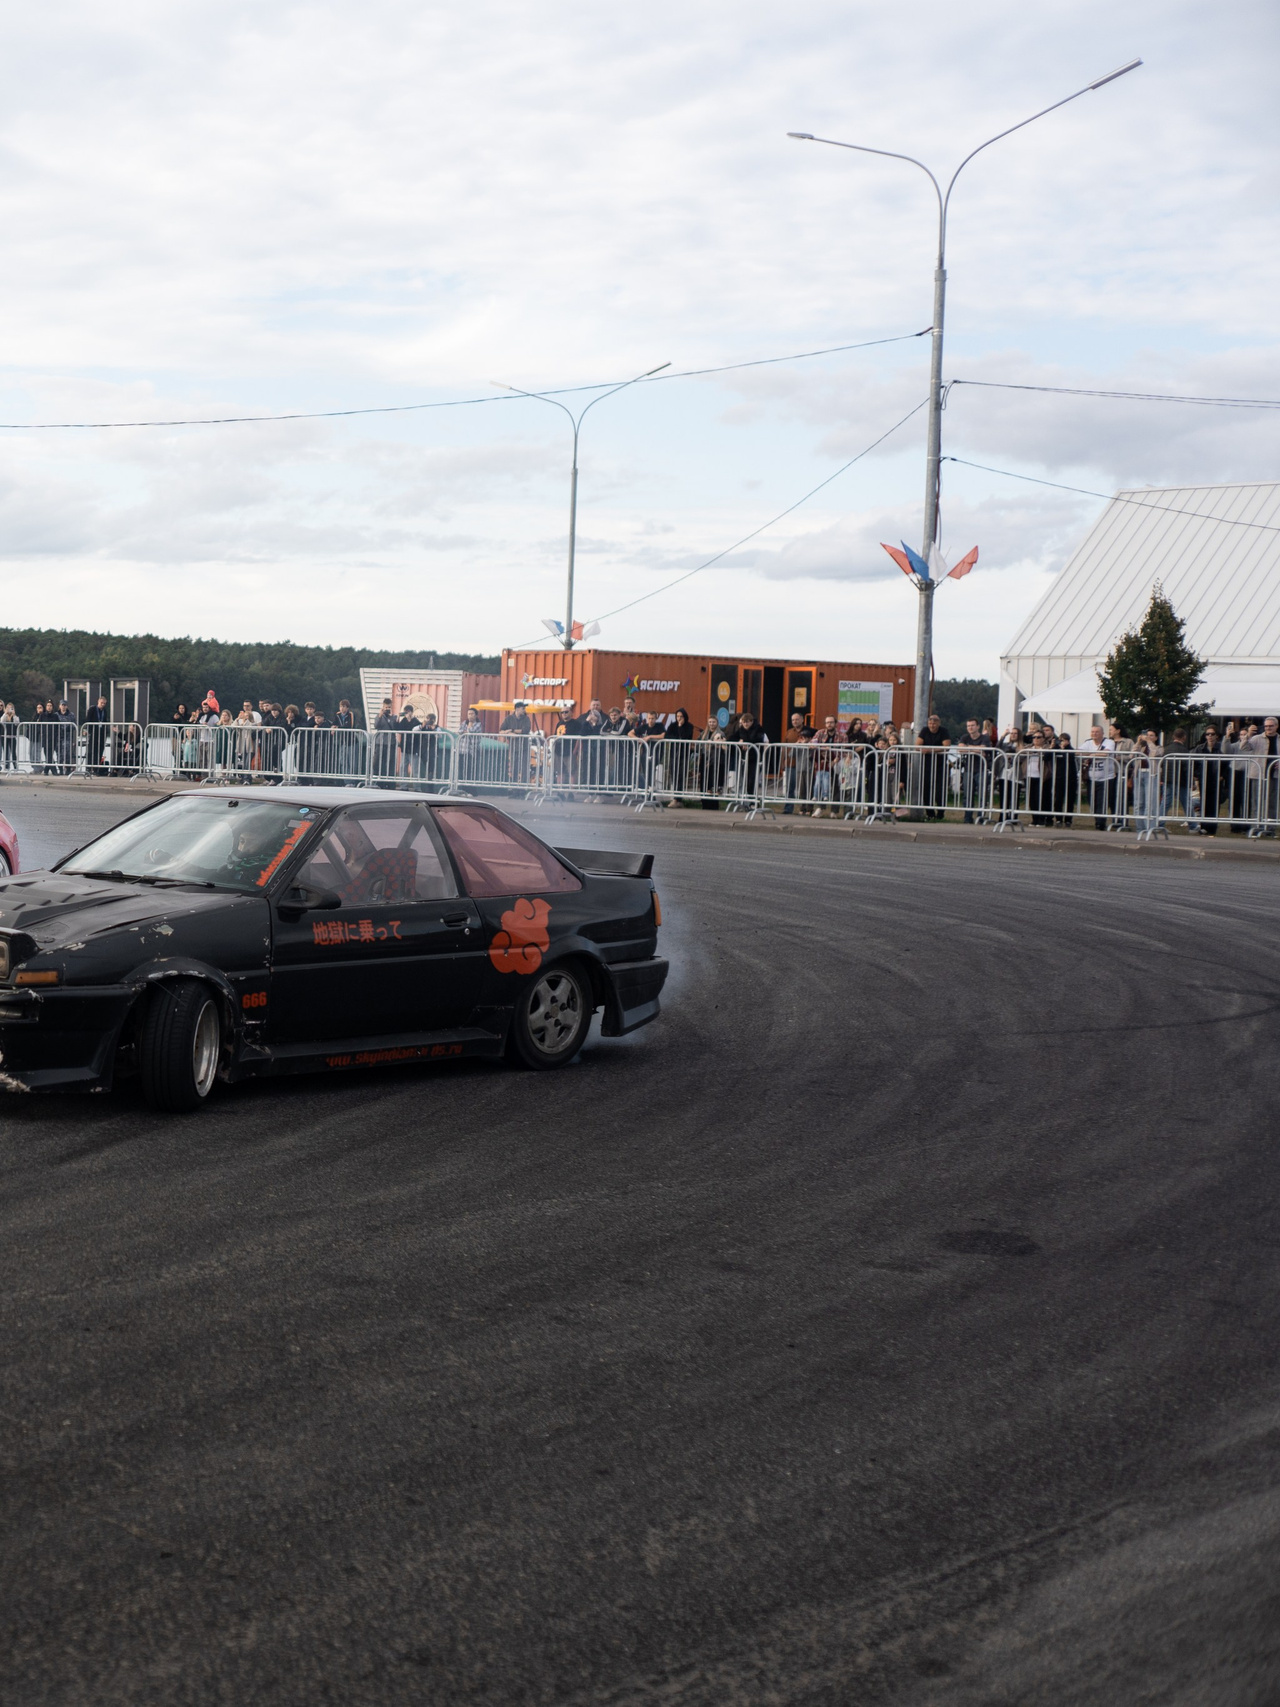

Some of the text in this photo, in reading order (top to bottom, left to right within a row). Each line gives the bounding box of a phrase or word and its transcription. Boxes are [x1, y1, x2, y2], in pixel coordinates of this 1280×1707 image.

[533, 677, 569, 687] ЯСПОРТ
[640, 679, 681, 692] ЯСПОРТ
[839, 682, 862, 690] ПРОКАТ
[312, 919, 403, 946] 地獄に乗って
[241, 991, 268, 1009] 666
